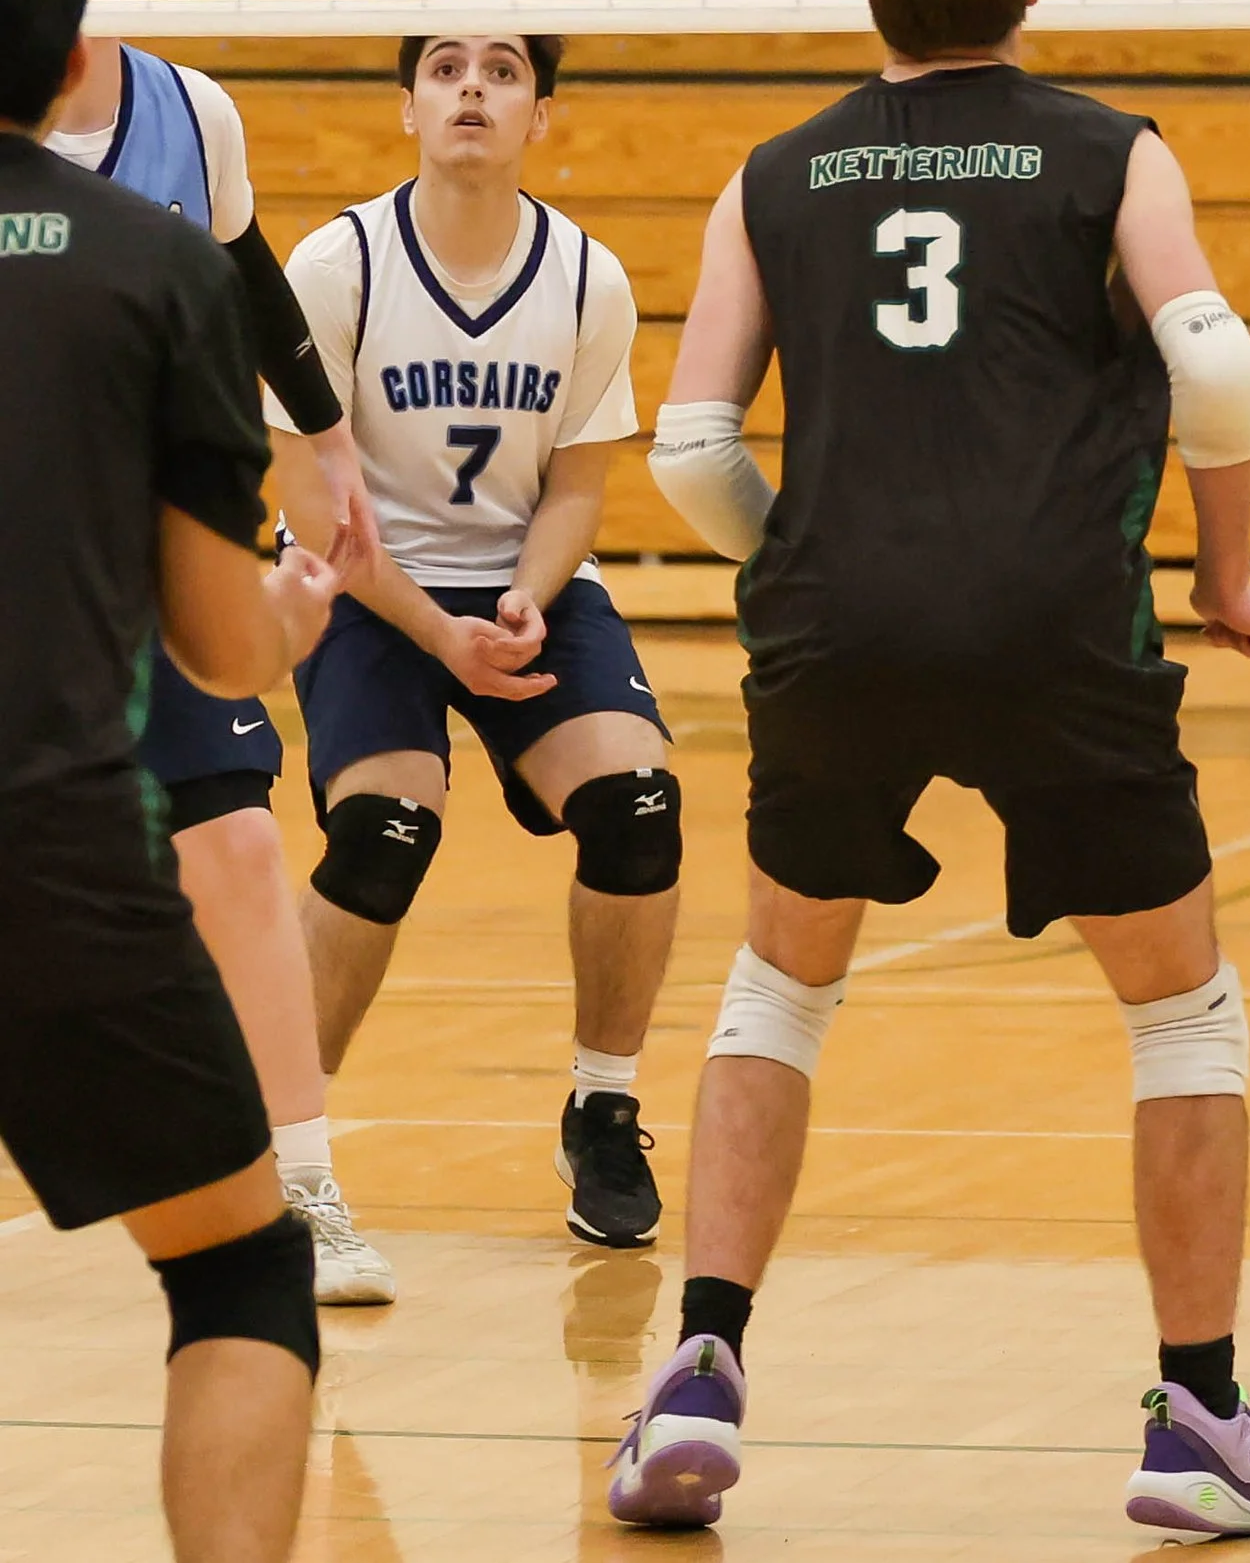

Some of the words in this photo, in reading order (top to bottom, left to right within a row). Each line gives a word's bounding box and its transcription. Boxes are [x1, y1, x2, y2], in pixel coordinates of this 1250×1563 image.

[809, 142, 1042, 189] KETTERING
[873, 207, 963, 351] 3
[382, 359, 562, 415] CORSAIRS
[445, 425, 502, 506] 7
